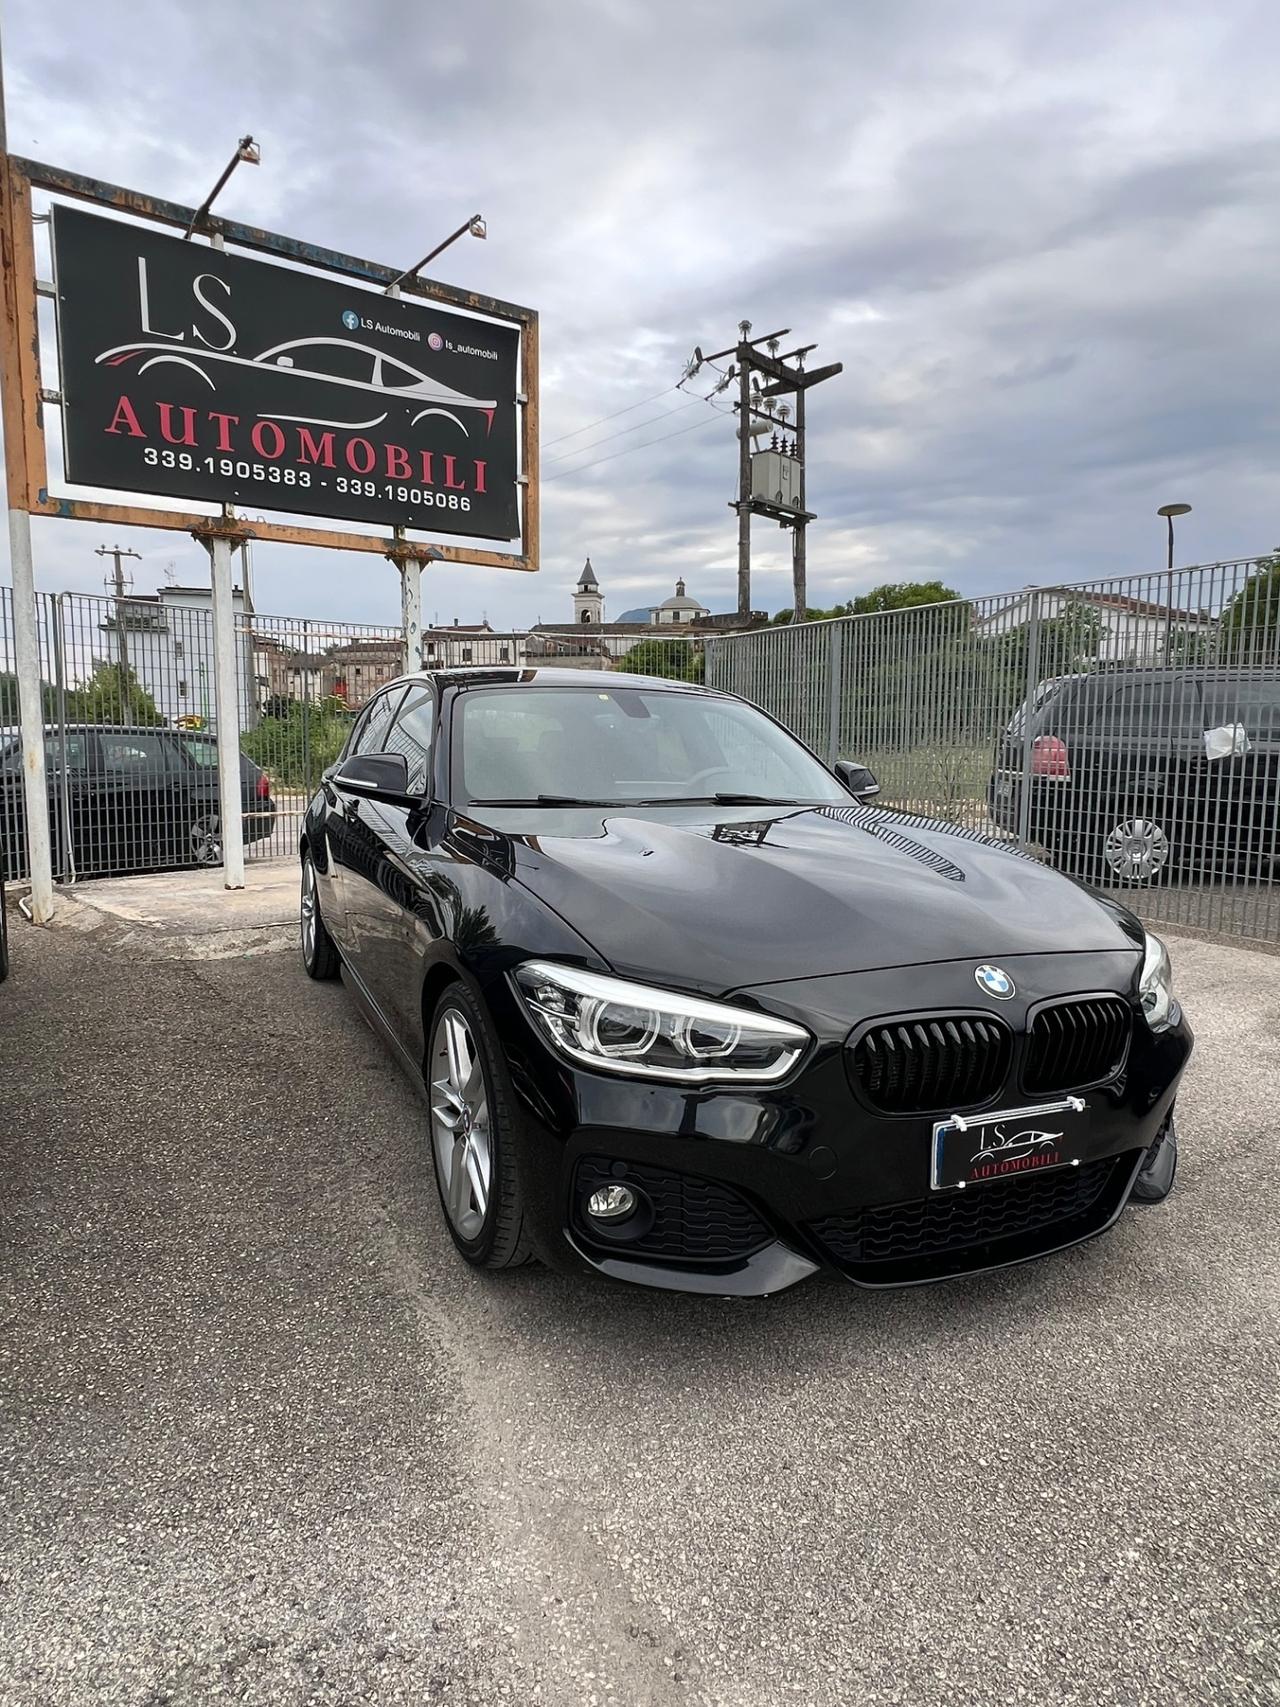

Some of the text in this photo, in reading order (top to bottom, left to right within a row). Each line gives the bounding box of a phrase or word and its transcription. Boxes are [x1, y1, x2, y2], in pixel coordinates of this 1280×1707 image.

[137, 256, 238, 351] LS
[360, 317, 421, 341] LS Automobili
[445, 339, 498, 361] ls_automobili
[104, 395, 488, 494] AUTOMOBILI
[144, 447, 312, 488] 339.1905383
[336, 476, 472, 512] 339.1905086
[980, 1124, 1006, 1150] LS
[970, 1151, 1061, 1179] AUTOMOBILI
